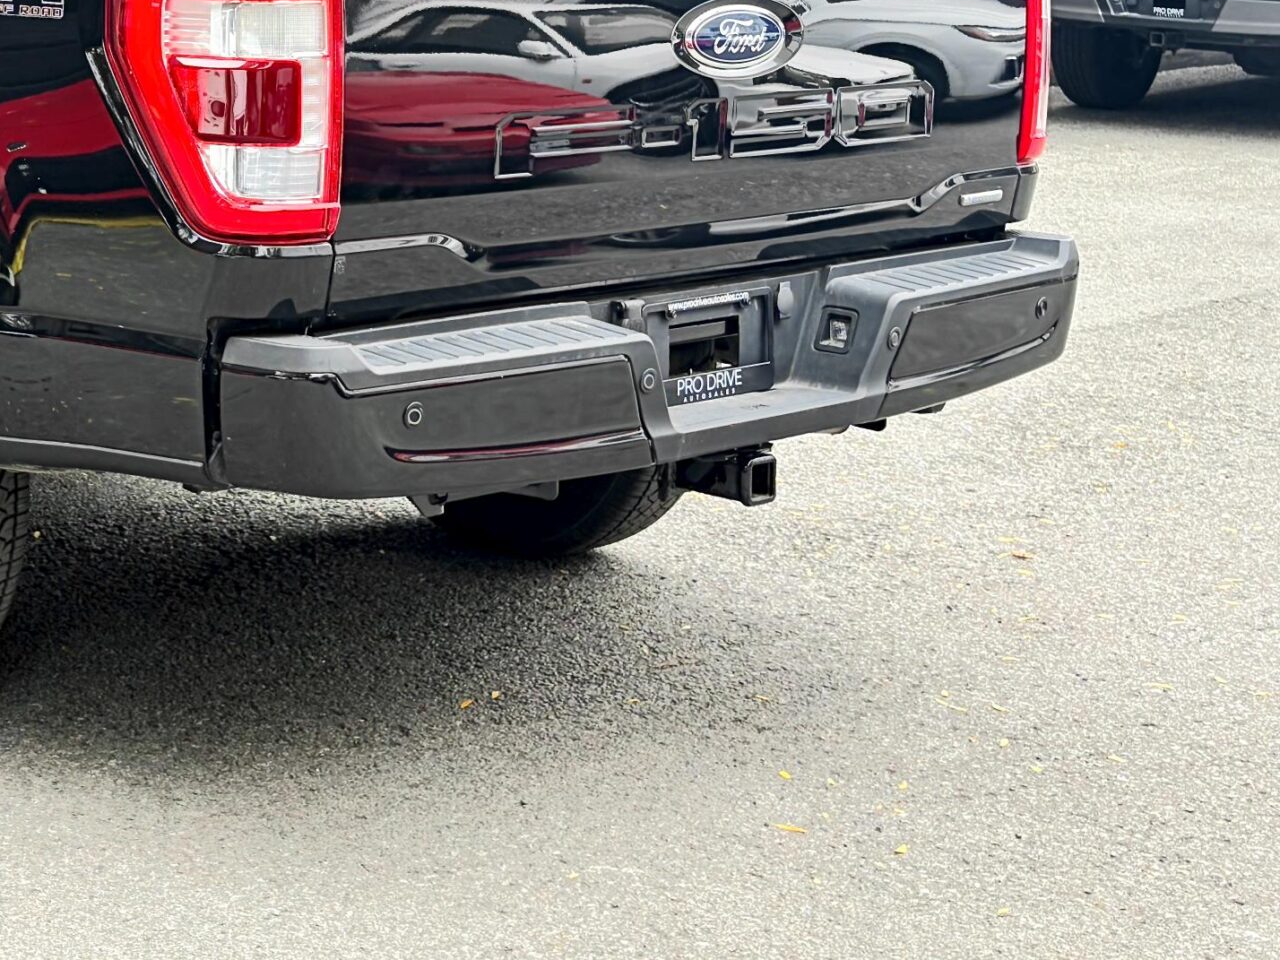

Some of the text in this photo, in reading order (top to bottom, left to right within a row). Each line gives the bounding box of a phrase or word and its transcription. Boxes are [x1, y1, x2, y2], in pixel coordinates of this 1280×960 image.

[19, 5, 64, 19] ROAD
[713, 18, 769, 55] Ford
[494, 79, 935, 180] F-150
[677, 369, 742, 397] PRO DRIVE
[683, 387, 736, 403] AUTOSALES
